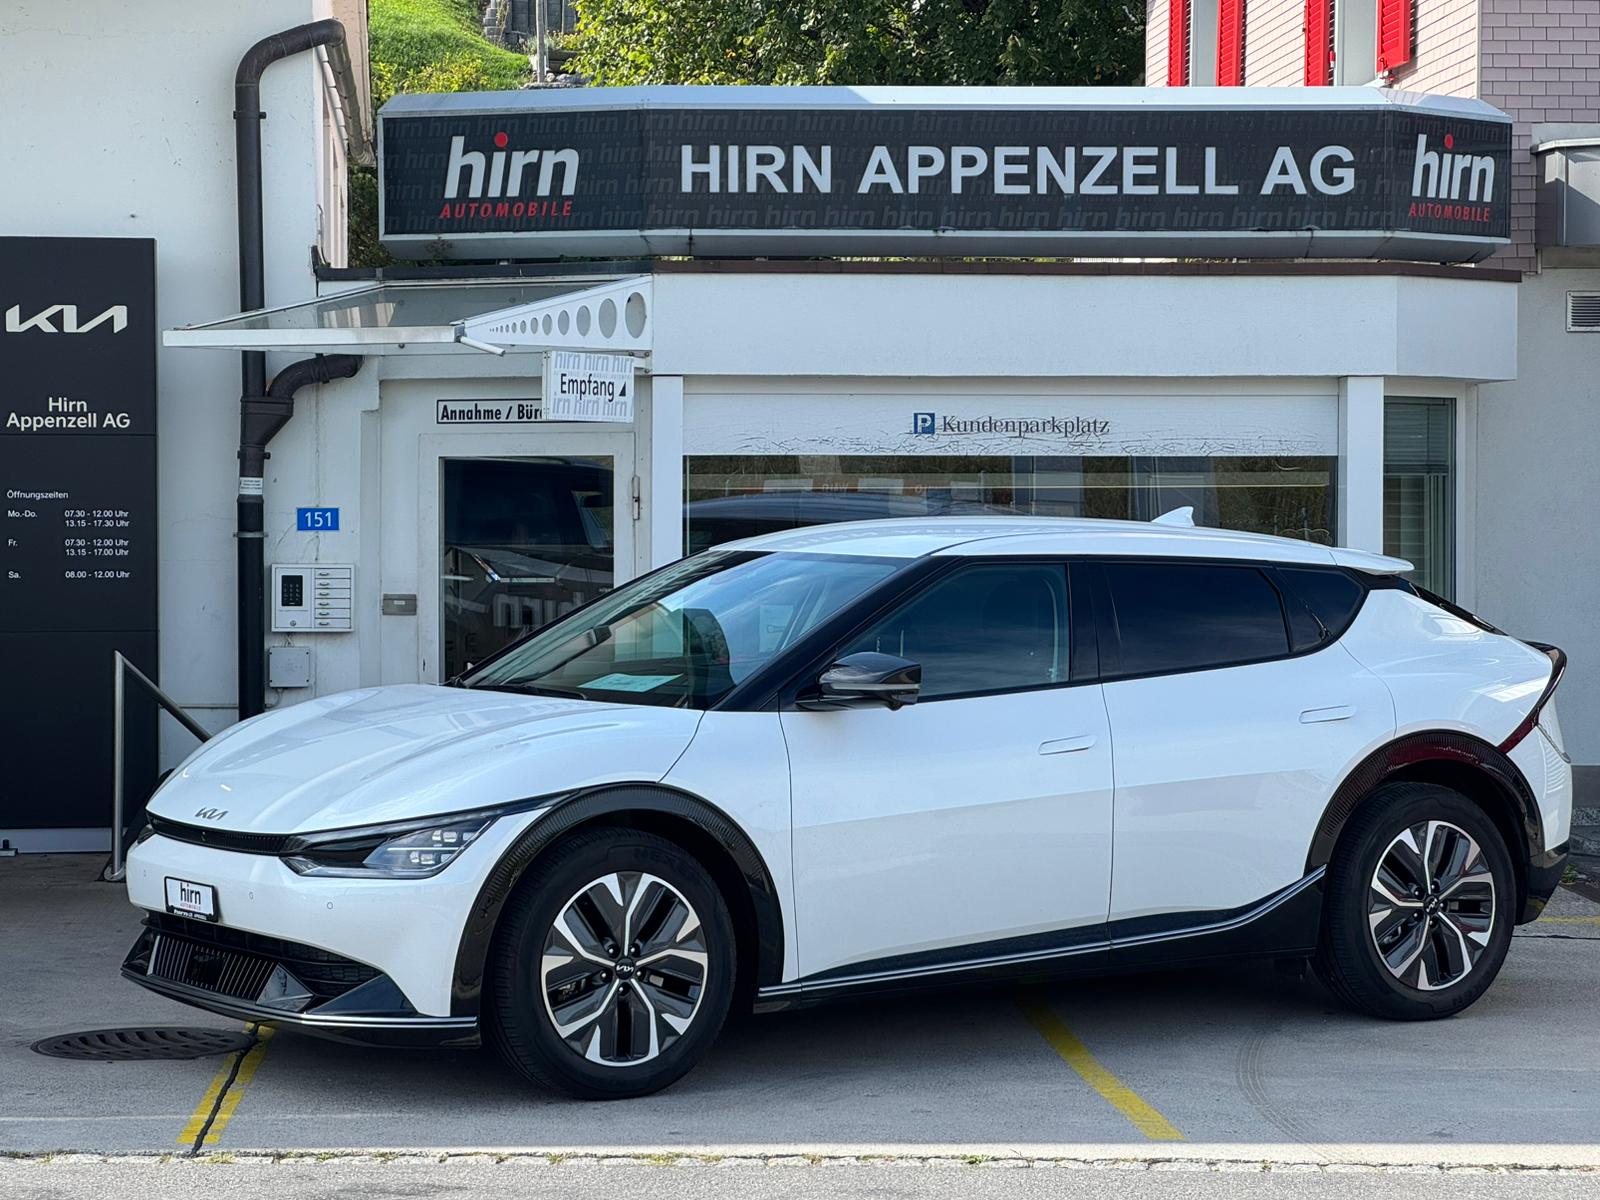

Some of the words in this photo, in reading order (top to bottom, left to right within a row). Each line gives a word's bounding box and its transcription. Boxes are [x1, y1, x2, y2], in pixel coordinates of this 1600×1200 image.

[444, 134, 579, 199] hirn
[681, 145, 832, 194] HIRN
[857, 145, 1239, 196] APPENZELL
[1260, 144, 1355, 196] AG
[1411, 133, 1495, 203] hirn
[440, 200, 573, 219] AUTOMOBILE
[1408, 202, 1491, 223] AUTOMOBILE
[560, 373, 615, 403] Empfang
[48, 396, 88, 410] Hirn
[440, 402, 502, 420] Annahme
[6, 411, 97, 431] Appenzell
[102, 412, 130, 426] AG
[943, 415, 1110, 438] Kundenparkplatz
[6, 489, 69, 500] Öffnungszeiten
[7, 510, 38, 518] Mo.-Do.
[305, 511, 332, 528] 151
[180, 882, 202, 905] hirn
